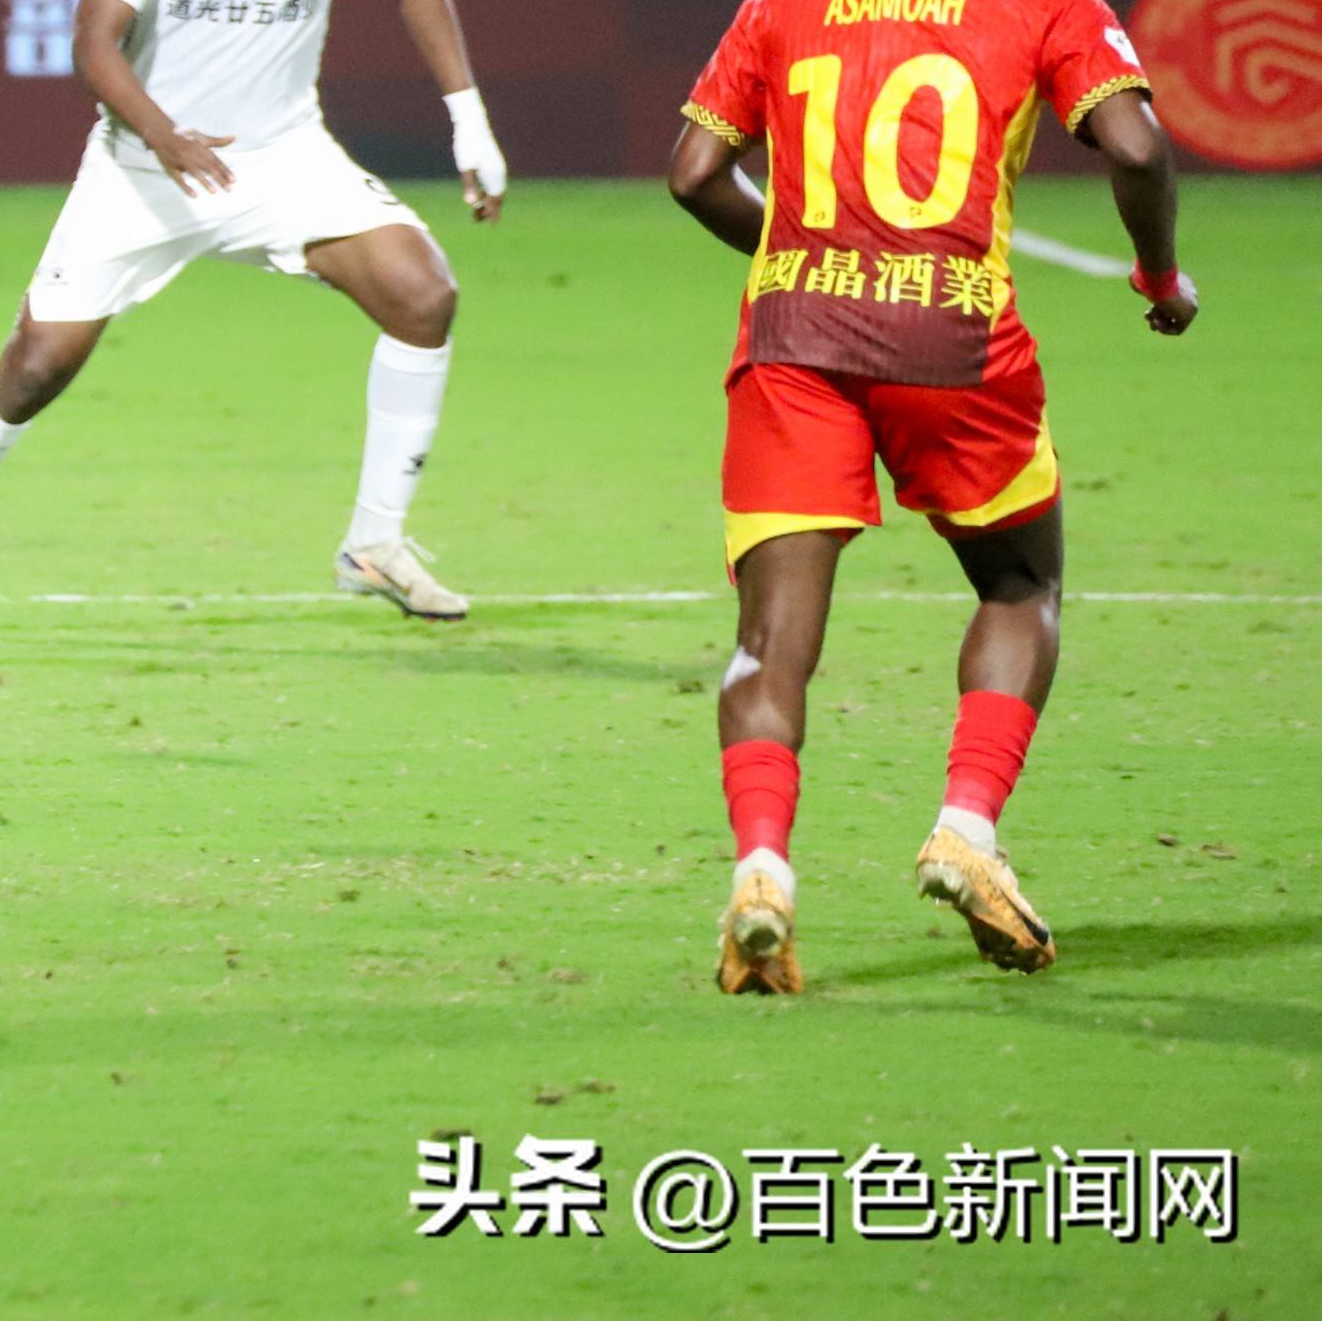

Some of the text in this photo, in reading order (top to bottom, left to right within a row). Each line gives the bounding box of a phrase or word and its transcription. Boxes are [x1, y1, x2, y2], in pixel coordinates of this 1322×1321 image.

[788, 53, 979, 230] 10
[754, 246, 994, 318] 國晶酒業
